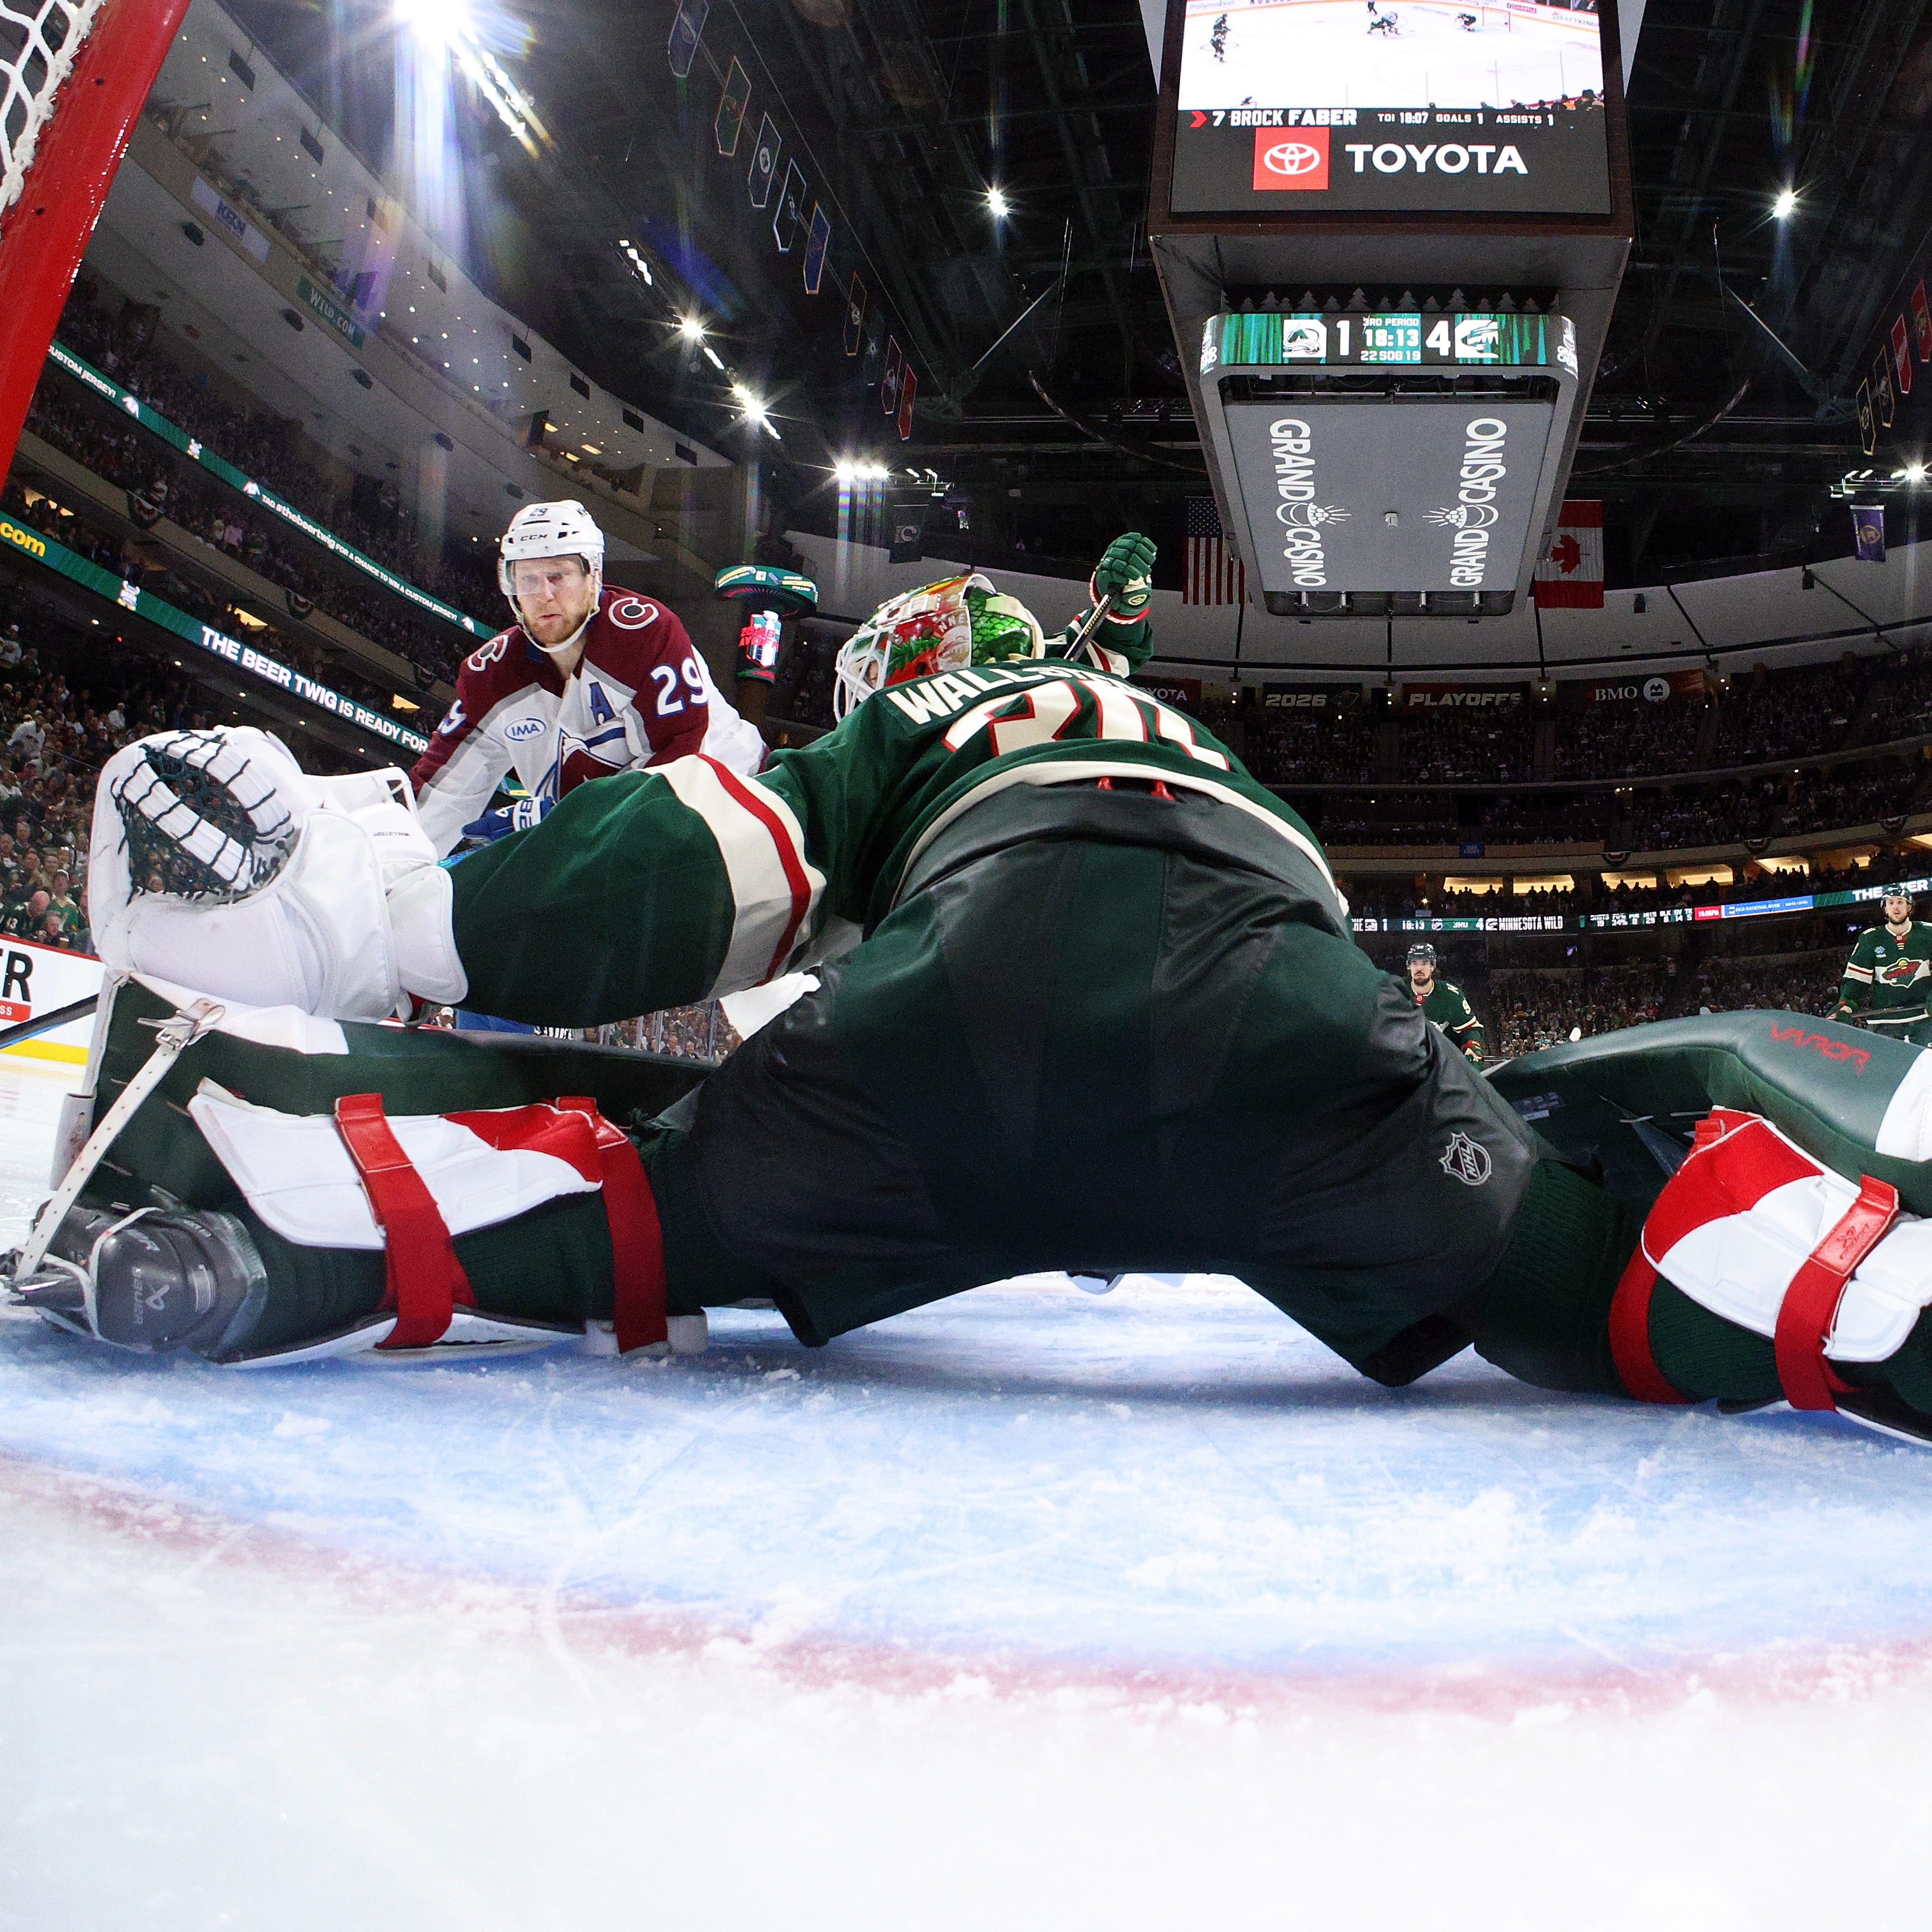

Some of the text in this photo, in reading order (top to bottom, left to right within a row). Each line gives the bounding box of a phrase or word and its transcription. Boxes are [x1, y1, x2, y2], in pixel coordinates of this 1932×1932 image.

[1212, 109, 1357, 126] 7 BROCK FABER
[1378, 113, 1395, 122] TOI
[1436, 113, 1471, 123] GOALS
[1477, 112, 1484, 125] 1
[1496, 114, 1542, 124] ASSISTS
[1547, 114, 1554, 126] 1
[1345, 143, 1528, 174] TOYOTA
[1363, 317, 1419, 327] 3RD PERIOD
[1336, 319, 1350, 356] 1
[1365, 328, 1419, 347] 18:13
[1425, 319, 1451, 357] 4
[1360, 350, 1421, 361] 22 SOG 19
[1269, 419, 1327, 586] GRAND CASINO
[1449, 418, 1508, 587] GRAND CASINO
[0, 522, 46, 557] com
[202, 625, 241, 661] THE
[241, 647, 292, 688] BEER
[294, 674, 338, 710] TWIG
[338, 699, 354, 718] IS
[354, 707, 401, 740] READY
[400, 730, 429, 753] FOR
[650, 656, 709, 718] 29
[1140, 686, 1188, 701] YOTA
[1595, 686, 1638, 702] BMO
[589, 681, 615, 727] A
[1265, 692, 1522, 707] 2026 PLAYOFFS
[511, 723, 540, 737] IMA
[1852, 886, 1883, 902] THE
[1475, 916, 1563, 931] 4 MINNESOTA WILD
[1611, 917, 1628, 926] 34%
[1771, 1021, 1871, 1077] VAPOR
